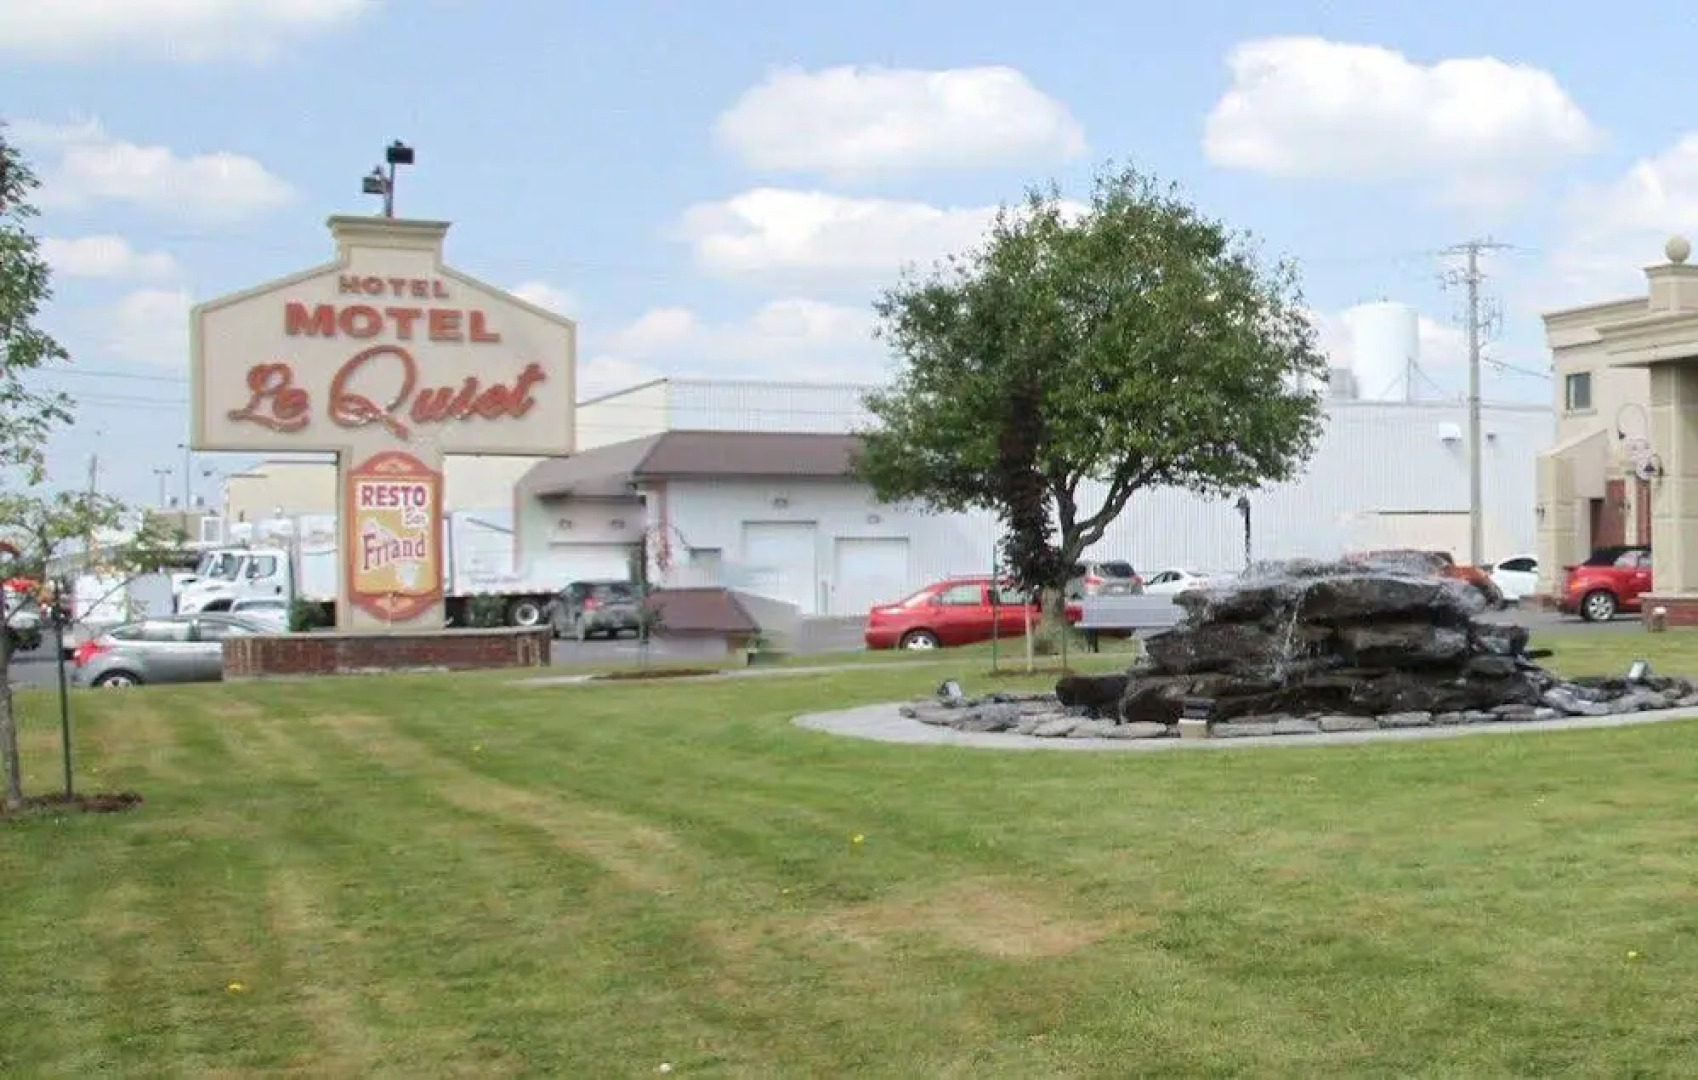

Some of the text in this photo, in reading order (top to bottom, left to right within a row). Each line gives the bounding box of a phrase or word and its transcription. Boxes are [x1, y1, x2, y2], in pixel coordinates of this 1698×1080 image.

[339, 275, 450, 298] HOTEL
[285, 303, 501, 342] MOTEL
[227, 344, 546, 441] Le Quiet
[361, 485, 426, 506] RESTO
[362, 532, 426, 570] Friand
